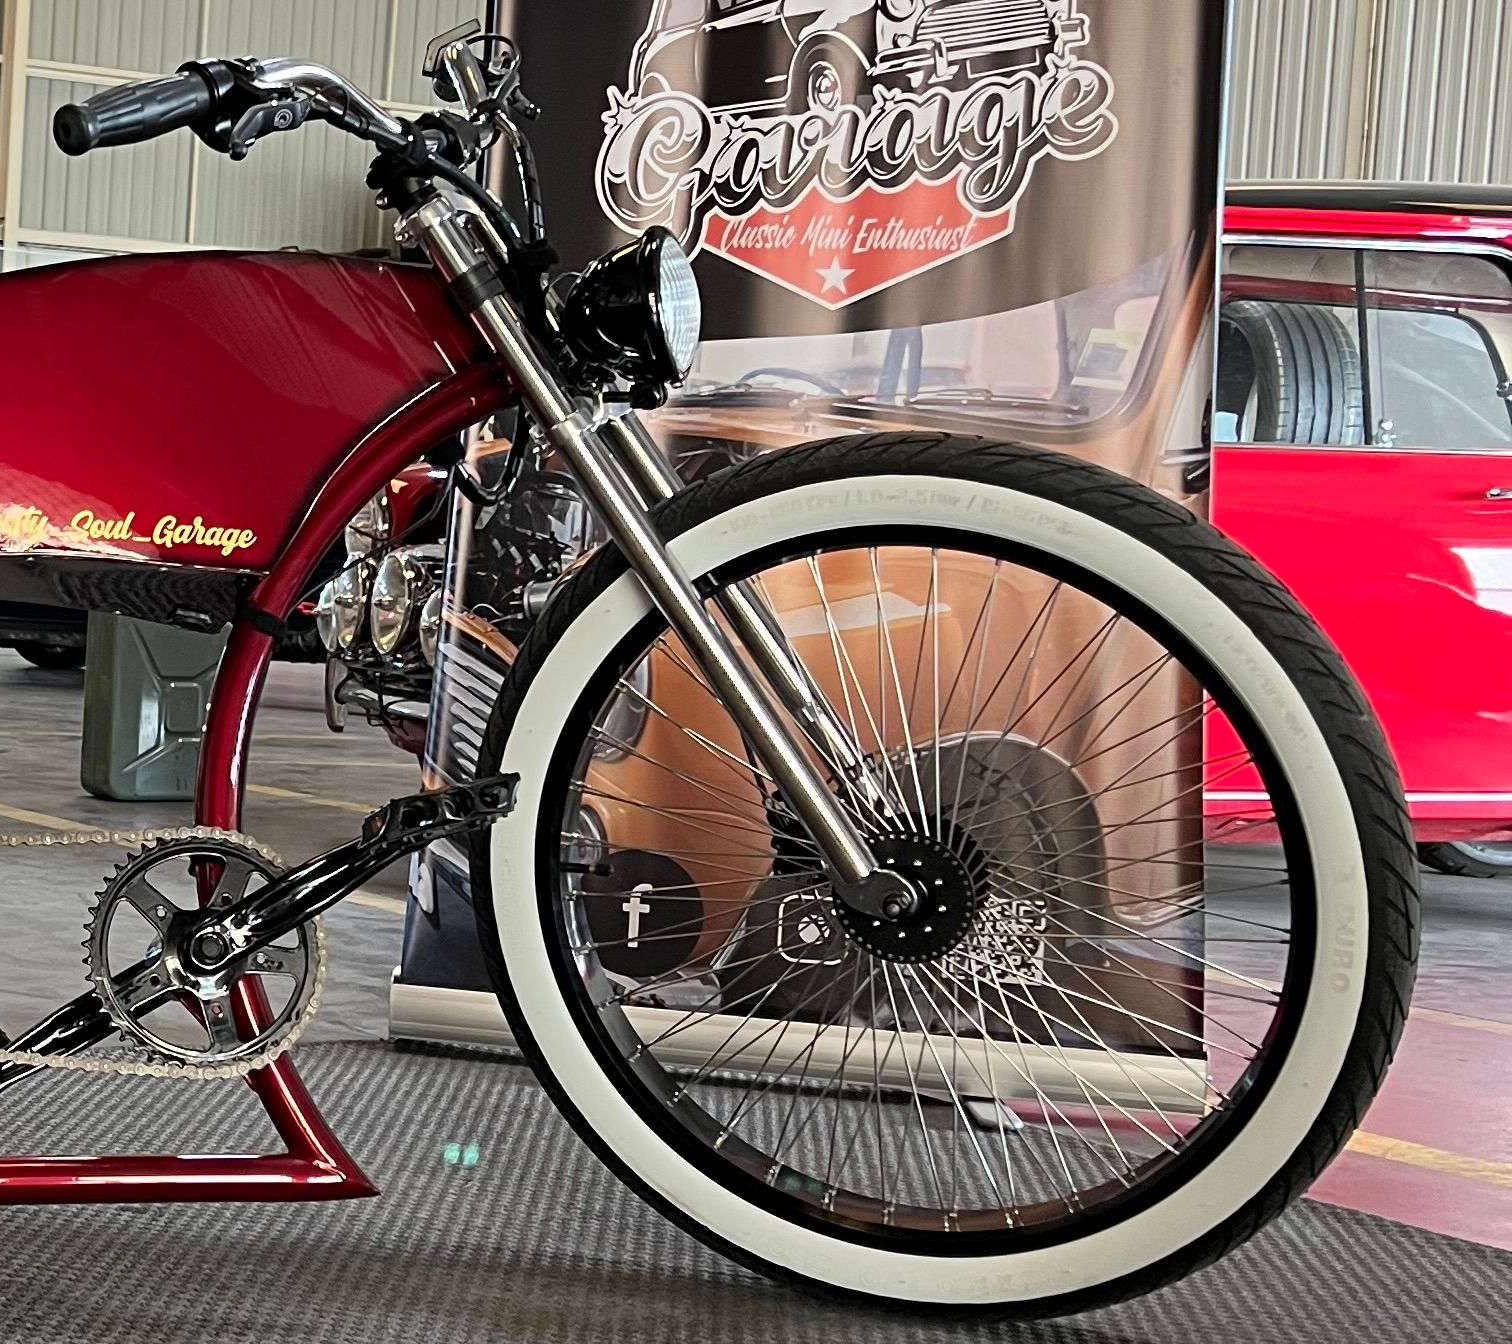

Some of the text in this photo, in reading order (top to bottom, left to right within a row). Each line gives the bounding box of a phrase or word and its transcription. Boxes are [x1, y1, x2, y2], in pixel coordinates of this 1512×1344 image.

[598, 56, 1118, 256] Garage
[720, 214, 978, 256] Classic Mini Enthusiast
[622, 882, 654, 948] f
